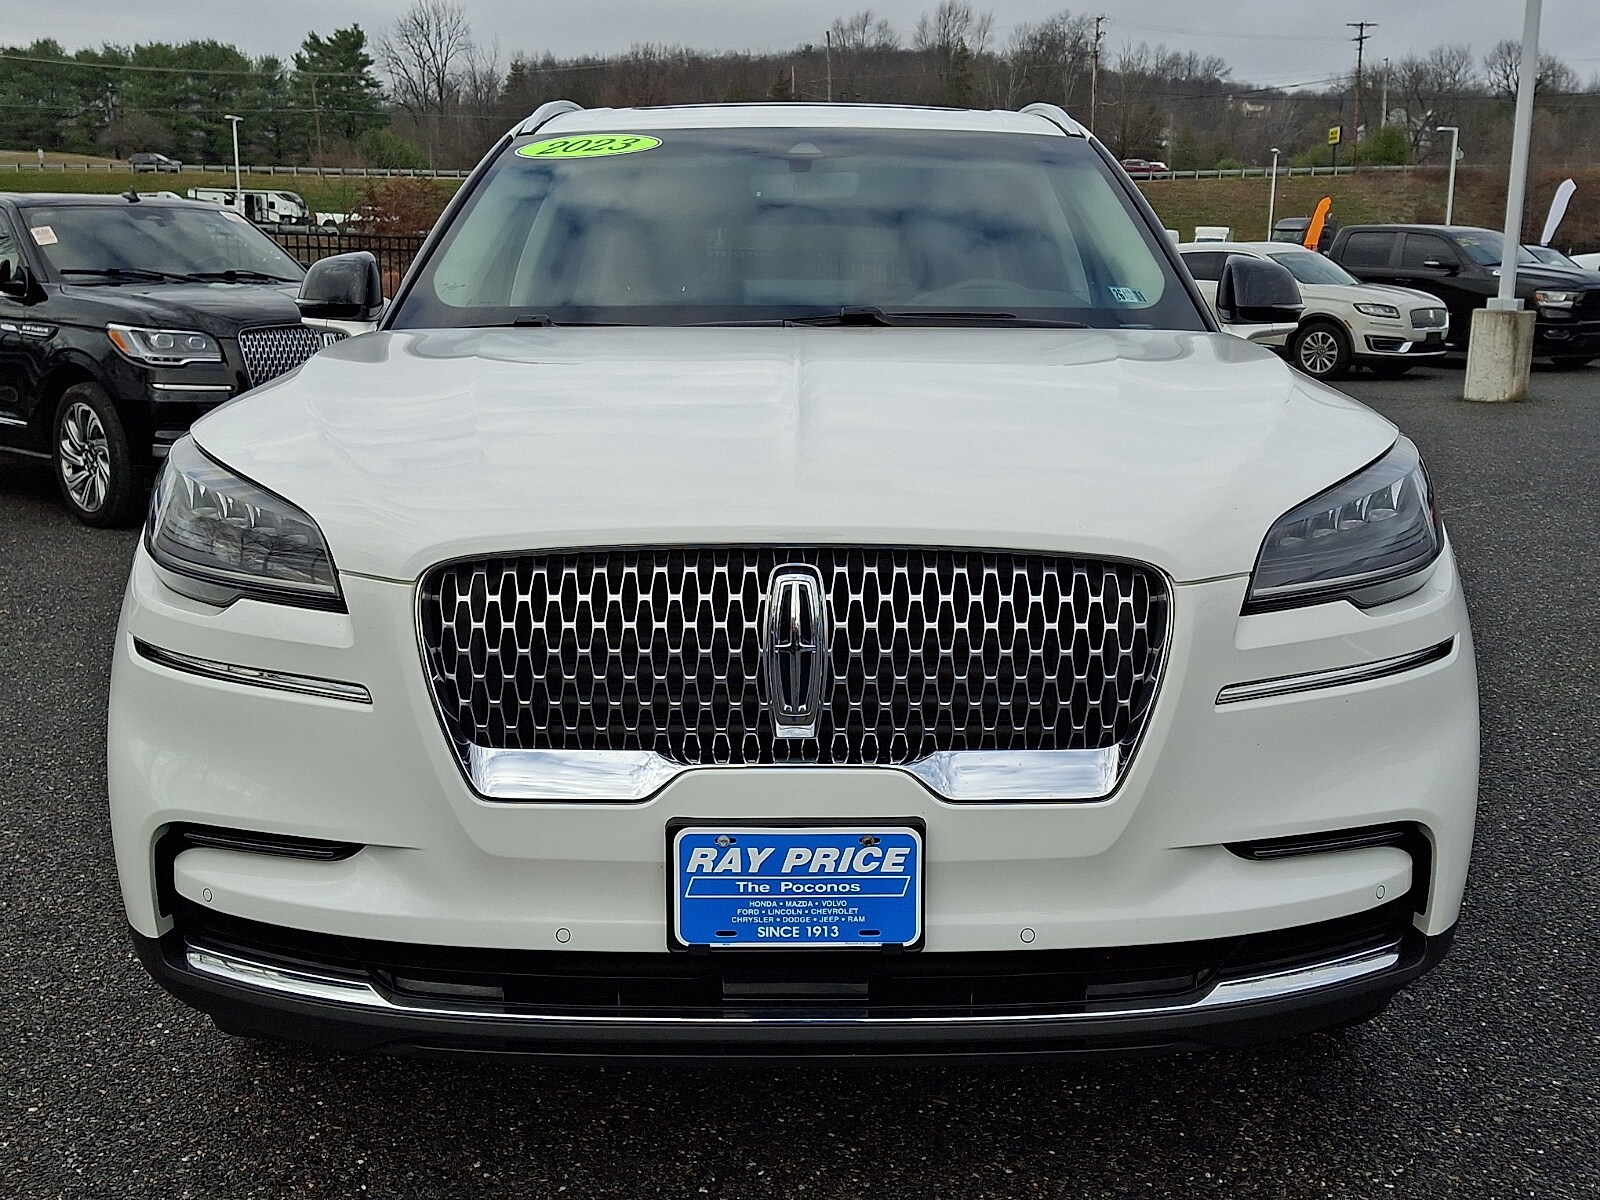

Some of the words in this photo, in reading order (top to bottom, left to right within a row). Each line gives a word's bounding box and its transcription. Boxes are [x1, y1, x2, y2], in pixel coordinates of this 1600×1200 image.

[536, 138, 640, 155] 2023
[686, 847, 776, 873] RAY
[781, 847, 911, 873] PRICE
[735, 881, 770, 893] The
[780, 881, 861, 893] Poconos
[821, 899, 848, 907] VOLVO
[810, 907, 859, 915] CHEVROLET
[731, 916, 774, 924] CHRYSLER
[847, 915, 866, 923] RAM
[757, 926, 800, 938] SINCE
[806, 925, 840, 938] 1913
